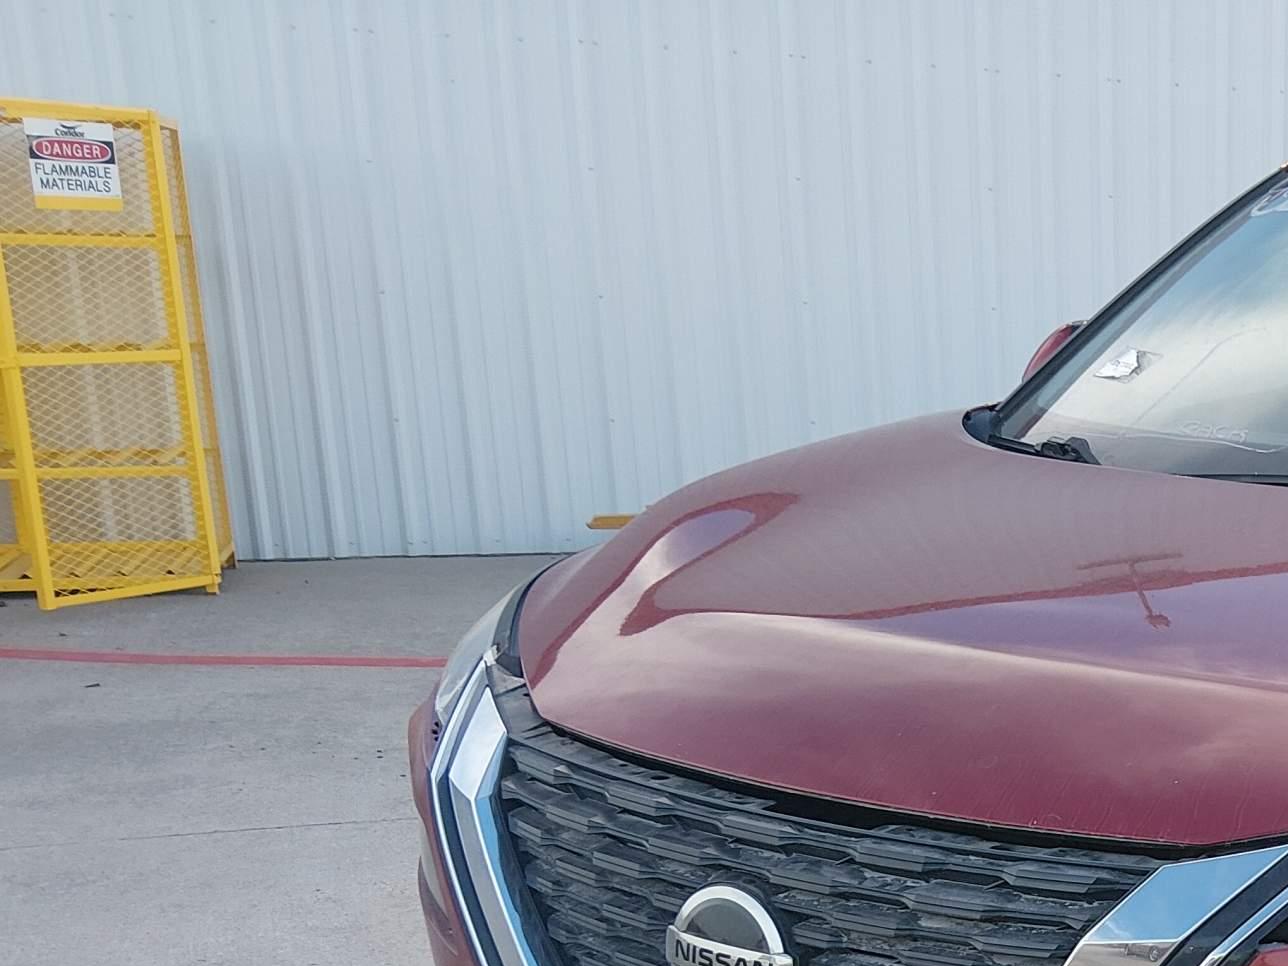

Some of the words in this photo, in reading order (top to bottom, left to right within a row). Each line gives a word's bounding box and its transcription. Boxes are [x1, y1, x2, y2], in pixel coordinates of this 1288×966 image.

[54, 127, 85, 138] Condor
[43, 141, 102, 159] DANGER
[35, 163, 112, 180] FLAMMABLE
[40, 177, 111, 193] MATERIALS
